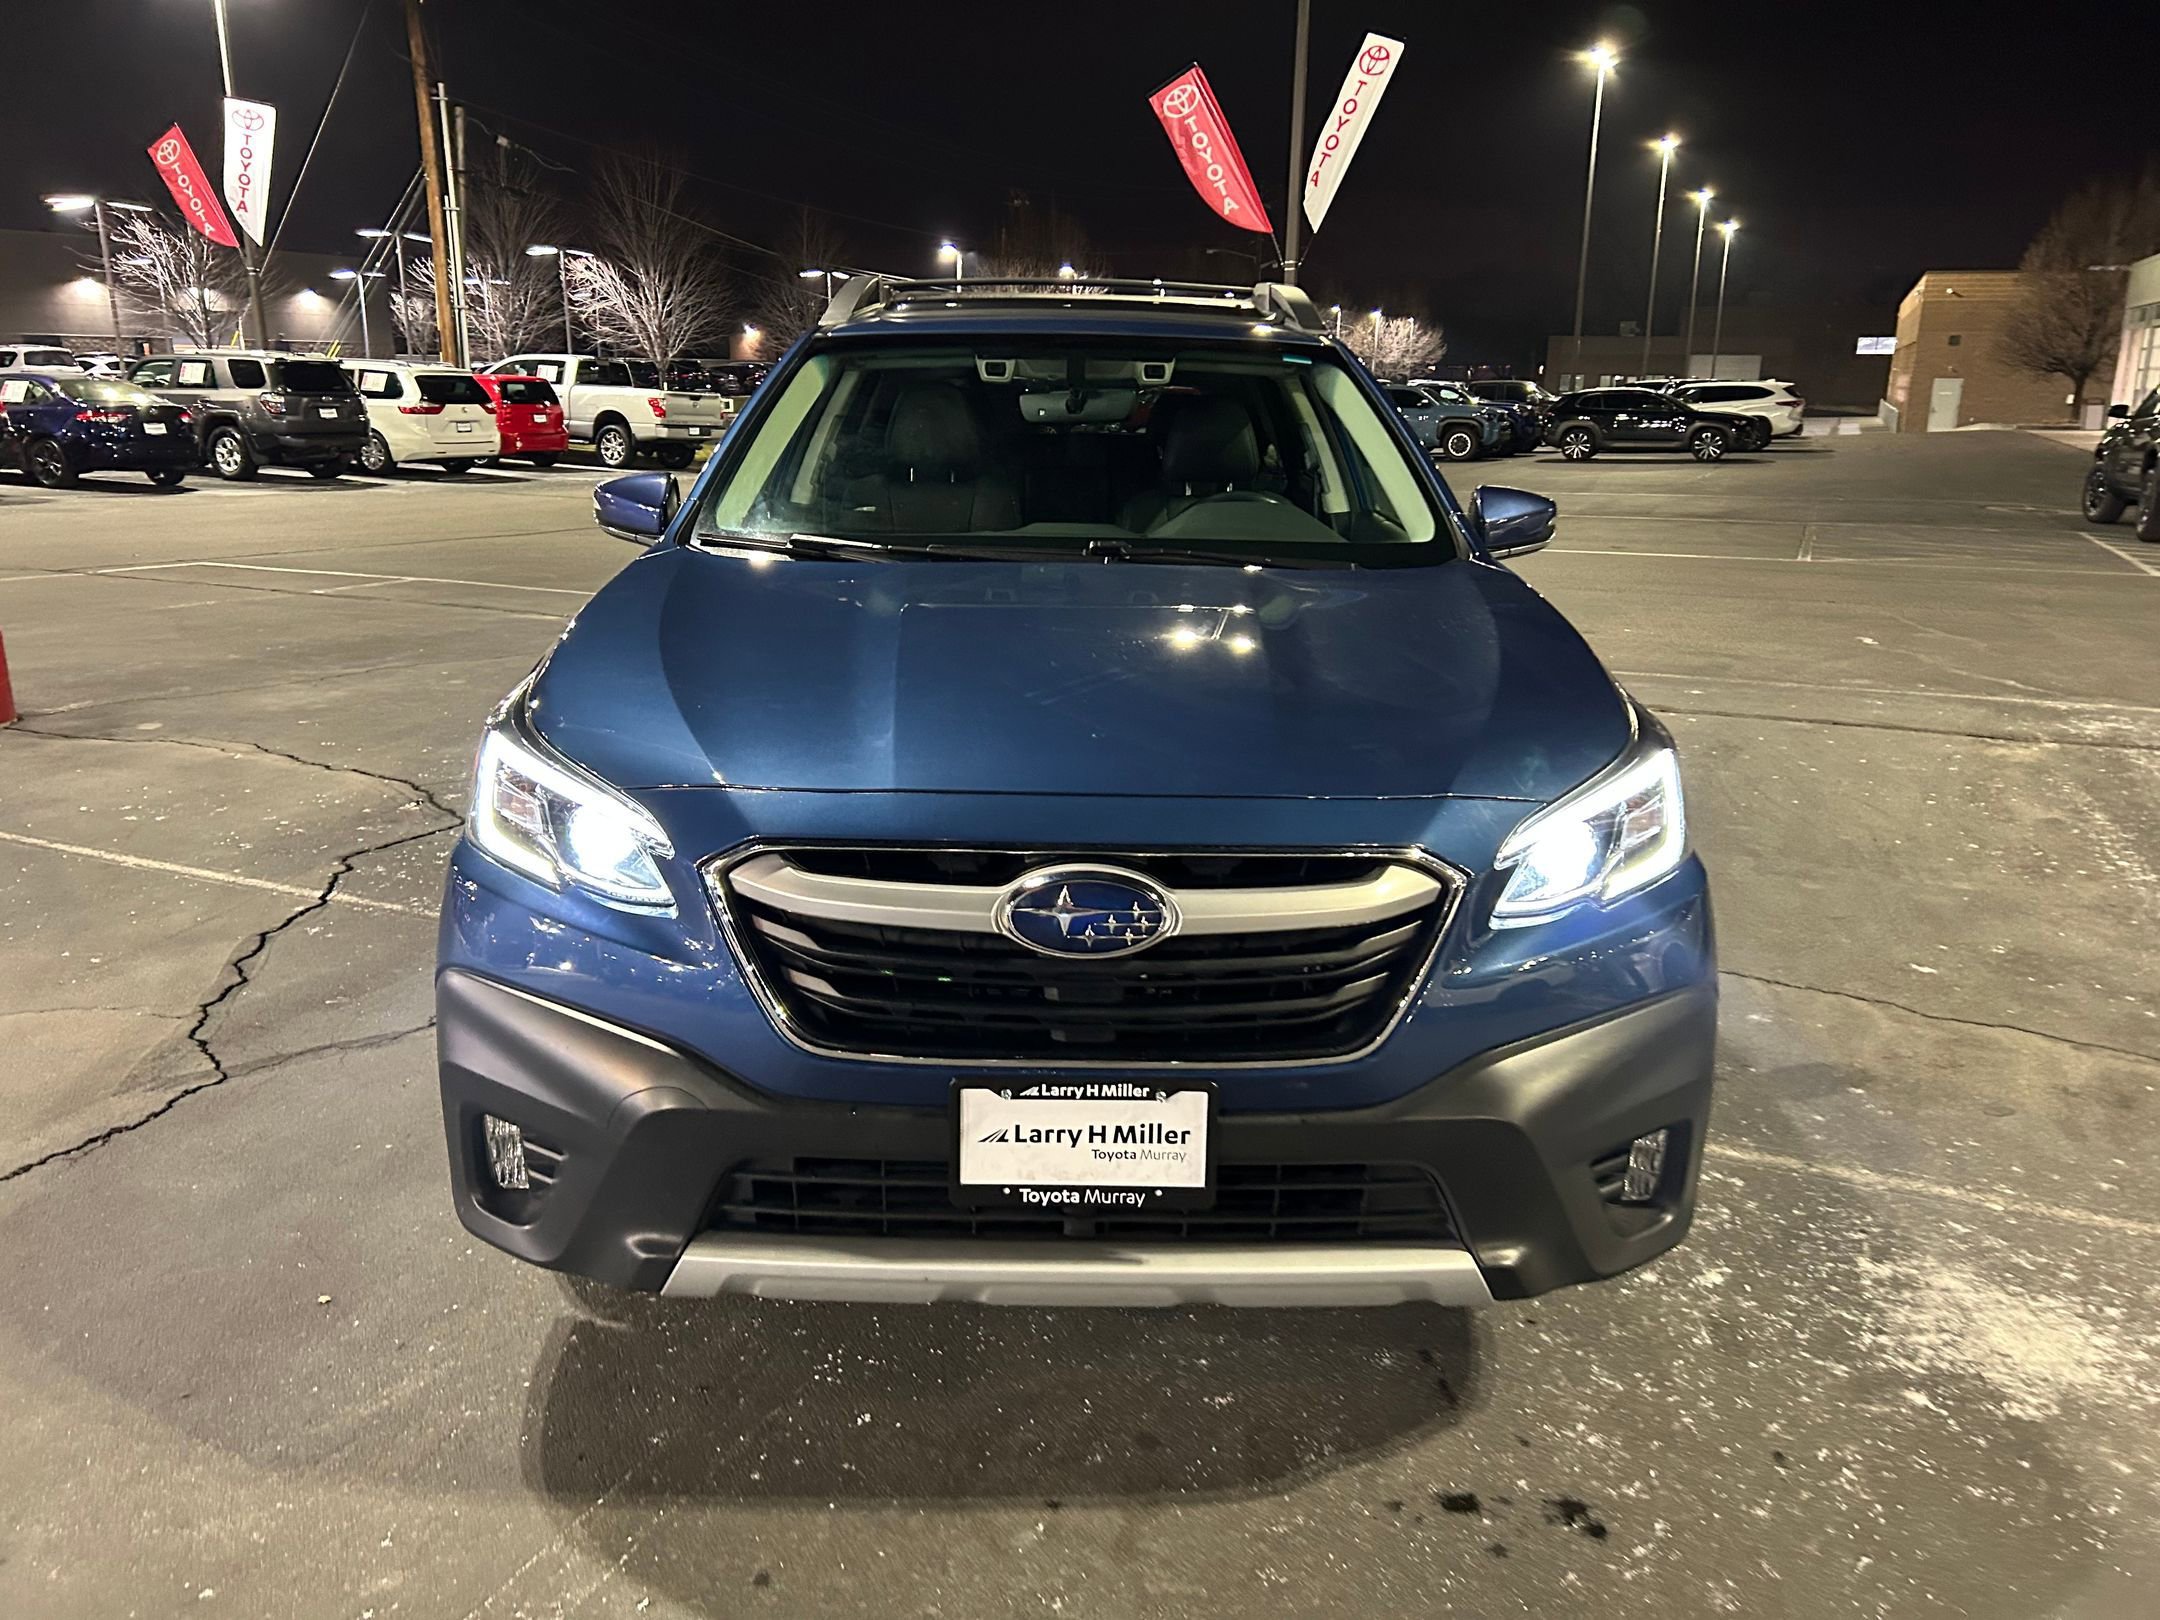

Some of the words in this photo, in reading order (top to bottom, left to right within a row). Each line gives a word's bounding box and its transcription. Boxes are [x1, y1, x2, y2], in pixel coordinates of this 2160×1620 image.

[1310, 80, 1367, 187] TOYOTA
[236, 134, 252, 213] TOYOTA
[1184, 115, 1239, 216] TOYOTA
[171, 162, 215, 236] TOYOTA
[1041, 1084, 1084, 1099] Larry
[1087, 1084, 1099, 1097] H
[1101, 1084, 1150, 1098] Miller
[1014, 1124, 1082, 1148] Larry
[1088, 1125, 1106, 1144] H
[1113, 1123, 1191, 1145] Miller
[1091, 1149, 1137, 1162] Toyota
[1140, 1149, 1187, 1162] Murray
[1019, 1188, 1080, 1206] Toyota
[1084, 1189, 1146, 1207] Murray
